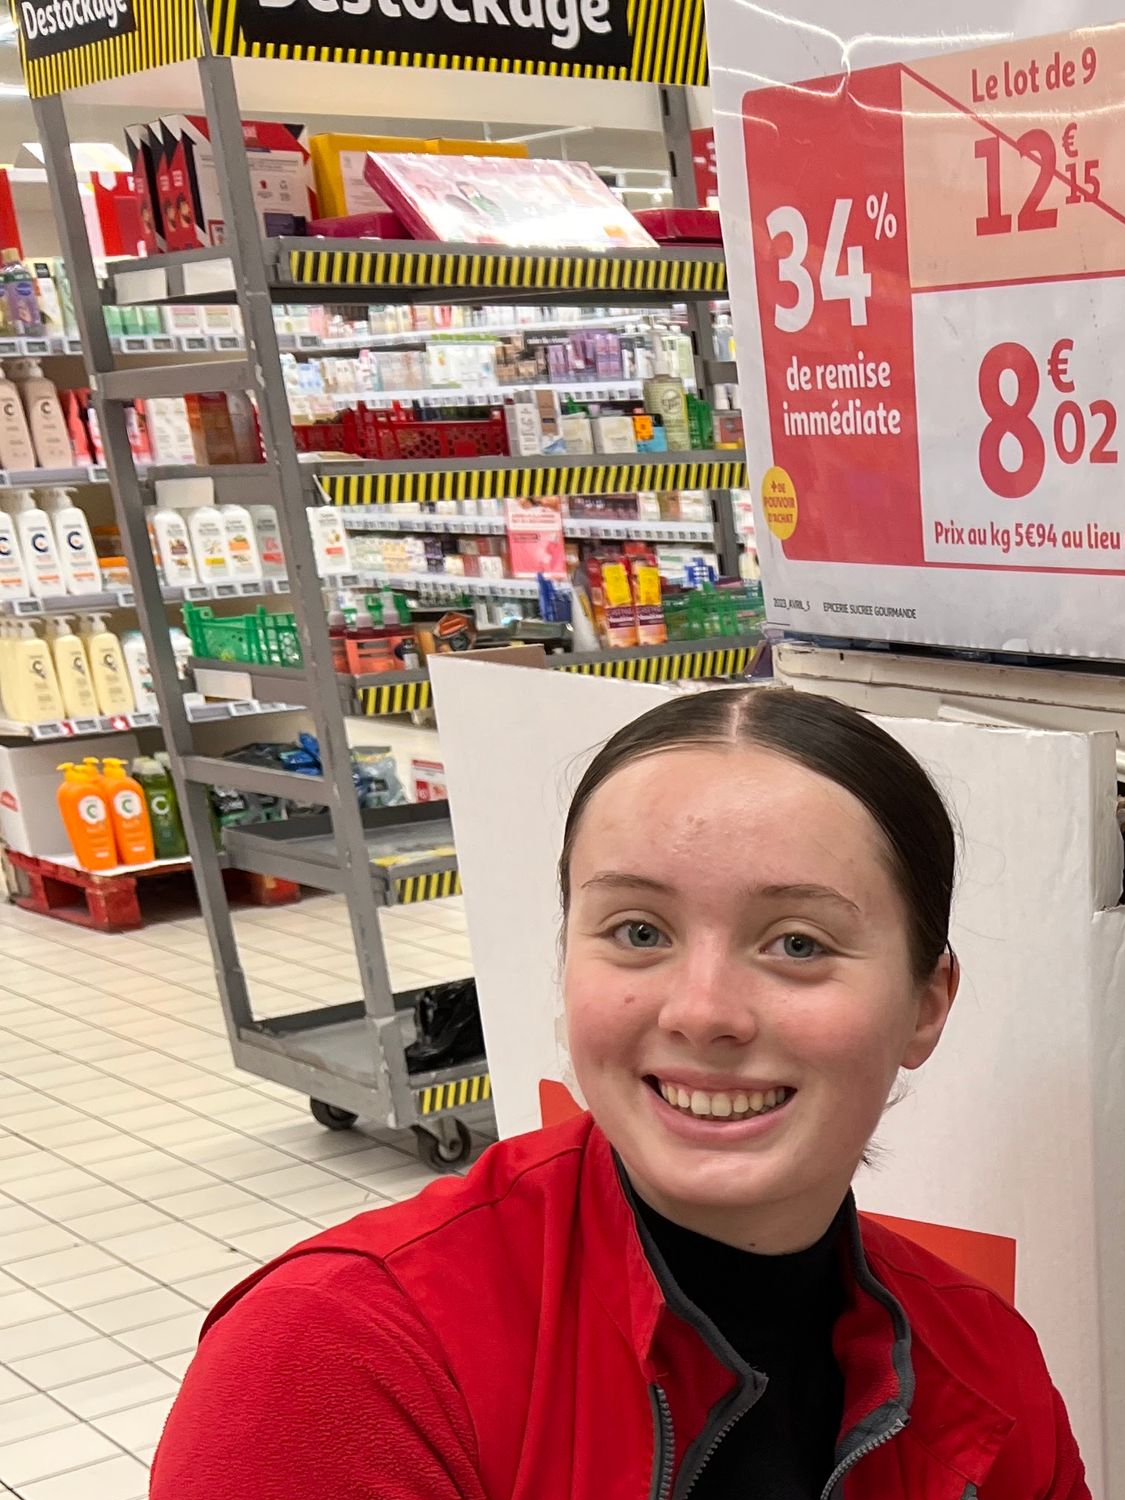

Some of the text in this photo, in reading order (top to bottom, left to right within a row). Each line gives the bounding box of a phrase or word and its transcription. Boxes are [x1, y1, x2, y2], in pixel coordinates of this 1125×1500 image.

[972, 47, 1097, 102] Le lot de 9
[786, 355, 890, 391] de remise
[783, 400, 900, 438] immédiate
[935, 520, 964, 546] Prix
[968, 526, 986, 546] au
[990, 522, 1011, 554] kg
[1015, 523, 1057, 548] 5€94
[1062, 527, 1083, 549] au
[1087, 522, 1120, 550] lieu
[823, 602, 848, 613] EPICERIE
[850, 605, 873, 615] SUCREE
[875, 607, 917, 619] GOURMANDE
